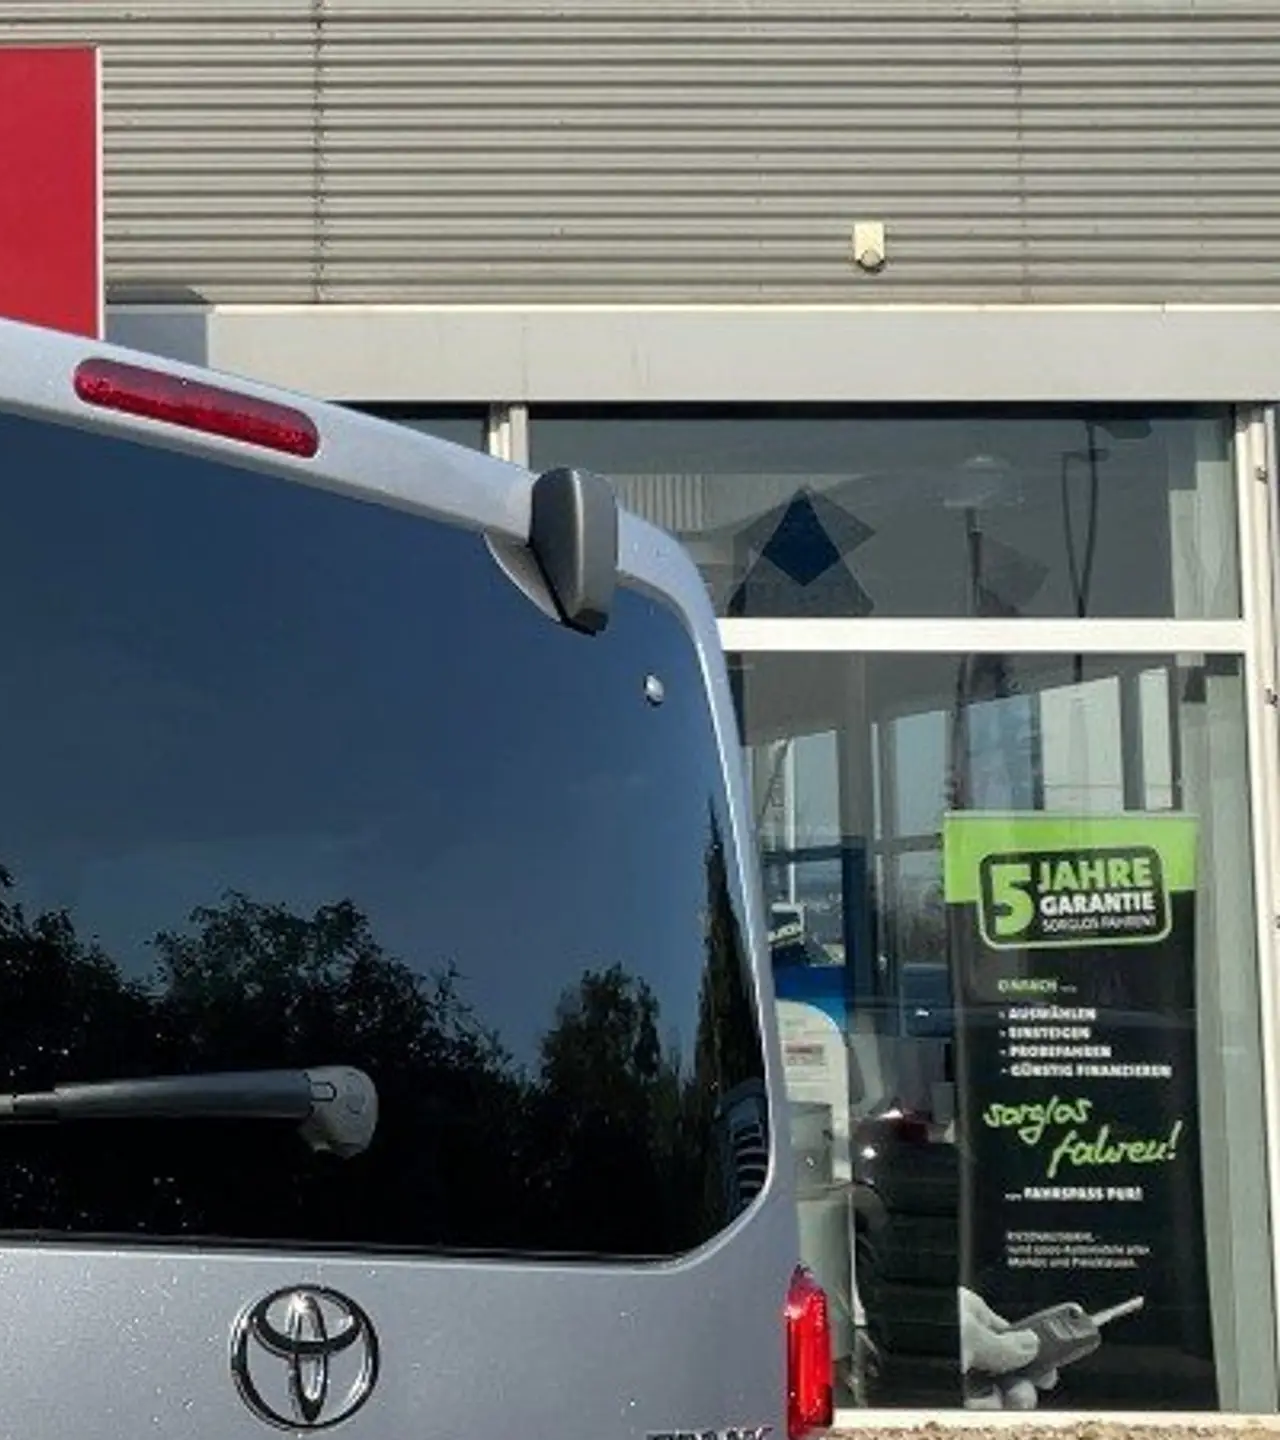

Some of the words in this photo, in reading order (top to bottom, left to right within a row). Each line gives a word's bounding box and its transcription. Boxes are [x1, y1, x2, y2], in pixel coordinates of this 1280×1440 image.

[991, 863, 1035, 936] 5
[1037, 857, 1154, 892] JAHRE
[1040, 892, 1157, 916] GARANTIE
[983, 1095, 1093, 1145] sorglos
